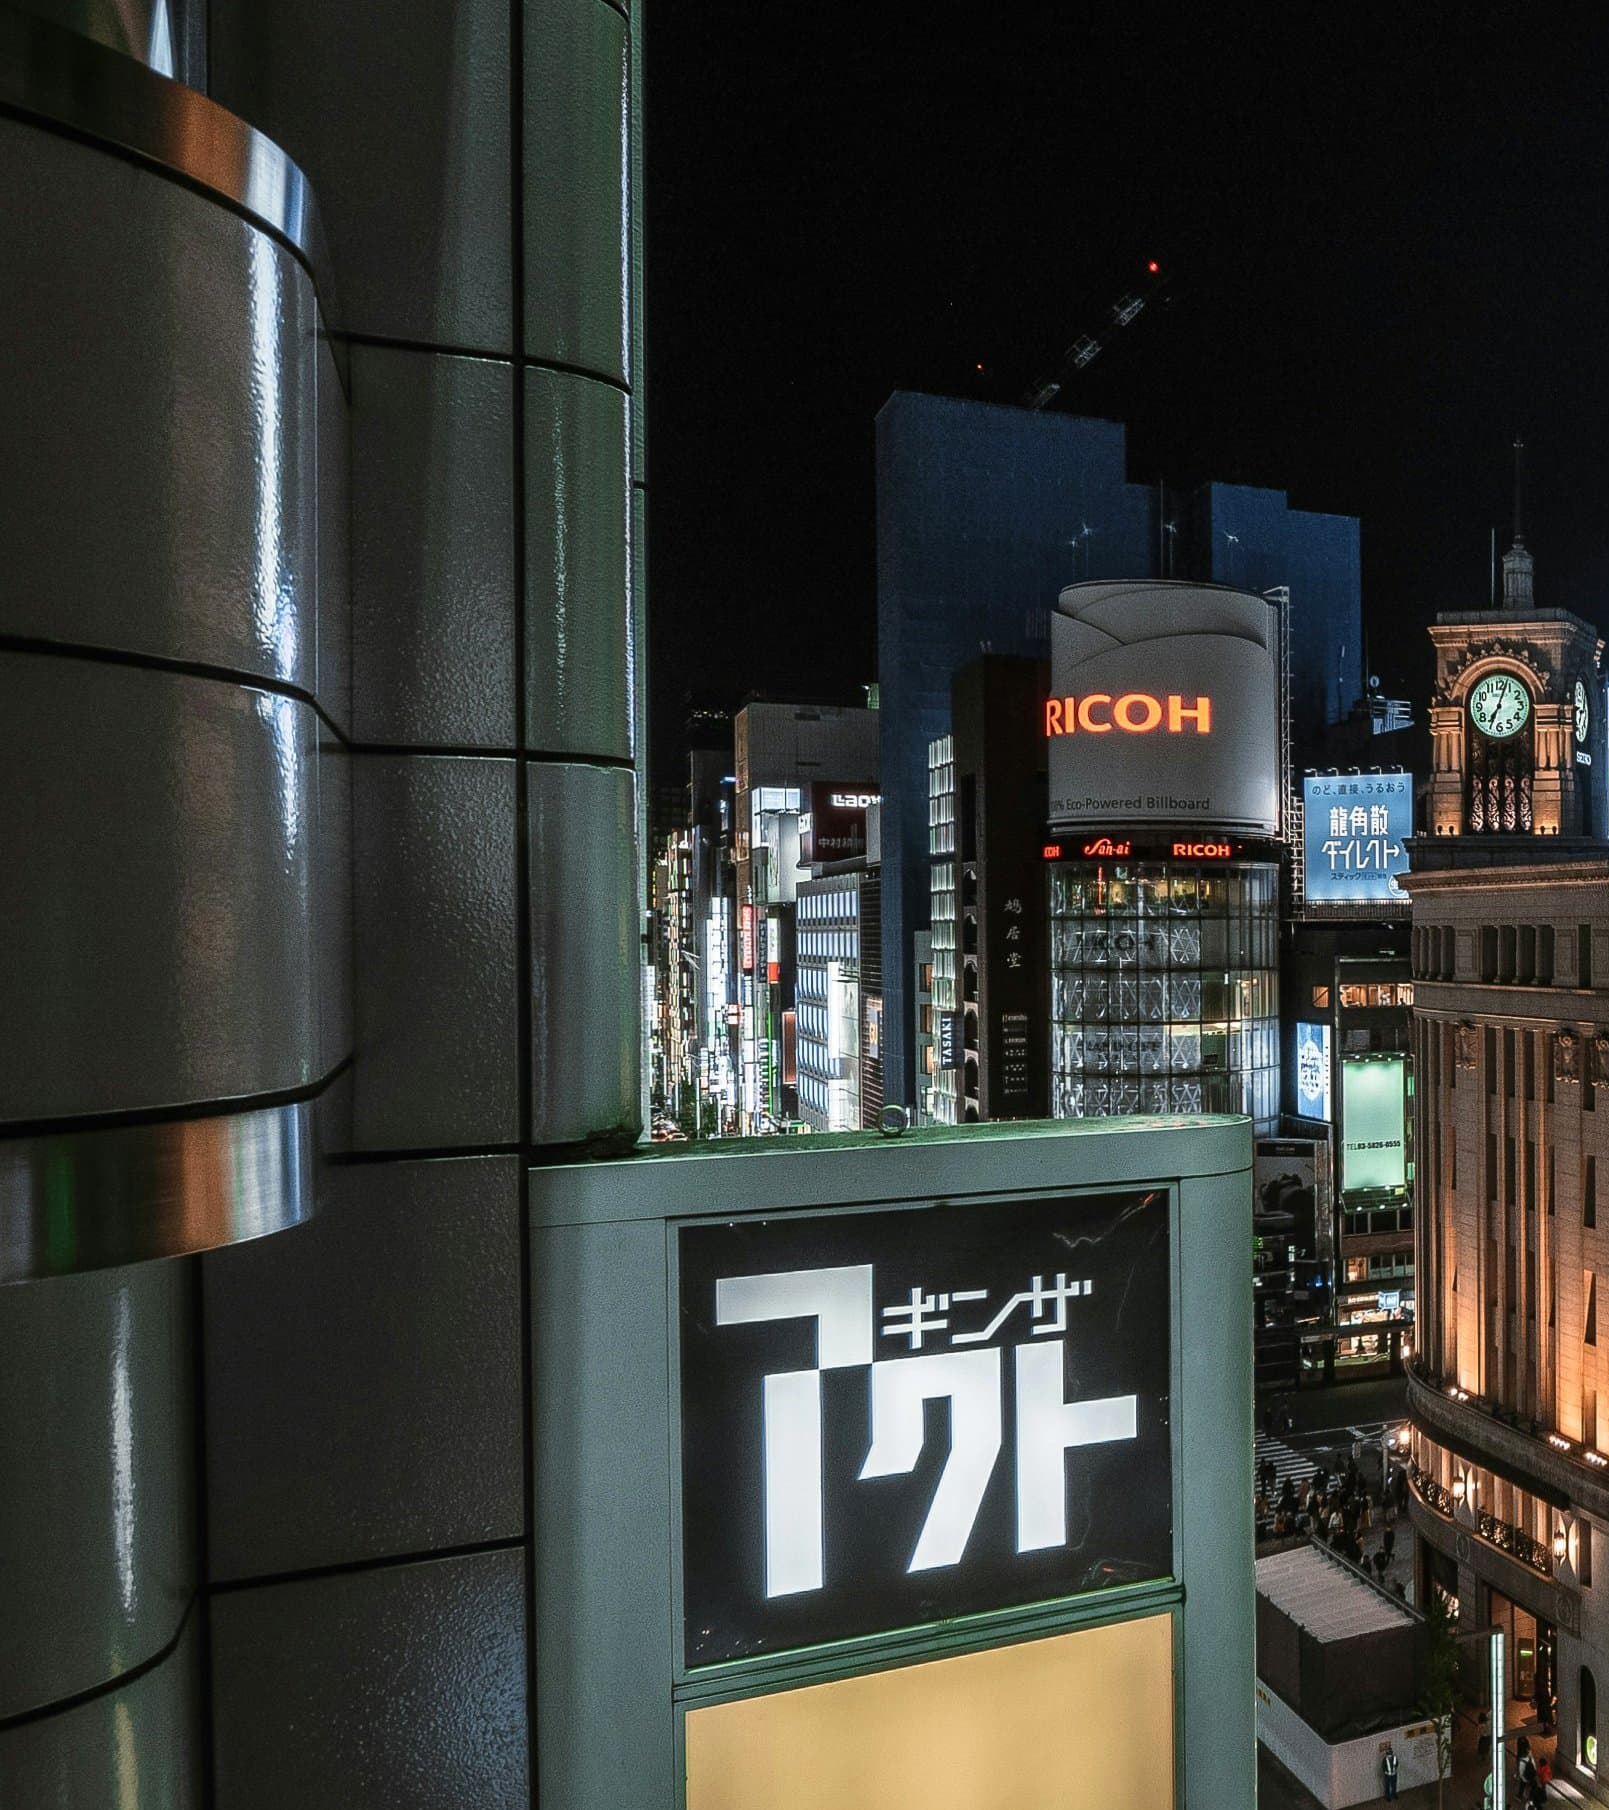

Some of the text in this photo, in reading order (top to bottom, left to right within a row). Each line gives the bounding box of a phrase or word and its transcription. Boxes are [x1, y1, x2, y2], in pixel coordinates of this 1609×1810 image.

[1046, 693, 1211, 736] RICOH
[1066, 796, 1142, 811] Eco-Powered
[1146, 796, 1210, 810] Billboard
[1329, 804, 1389, 837] 龍角散
[1173, 843, 1231, 857] RICOH
[1321, 839, 1400, 870] ダイレクト
[941, 1017, 953, 1065] TASAKI
[882, 1272, 1093, 1350] ギンザ
[715, 1263, 1138, 1599] アクト
